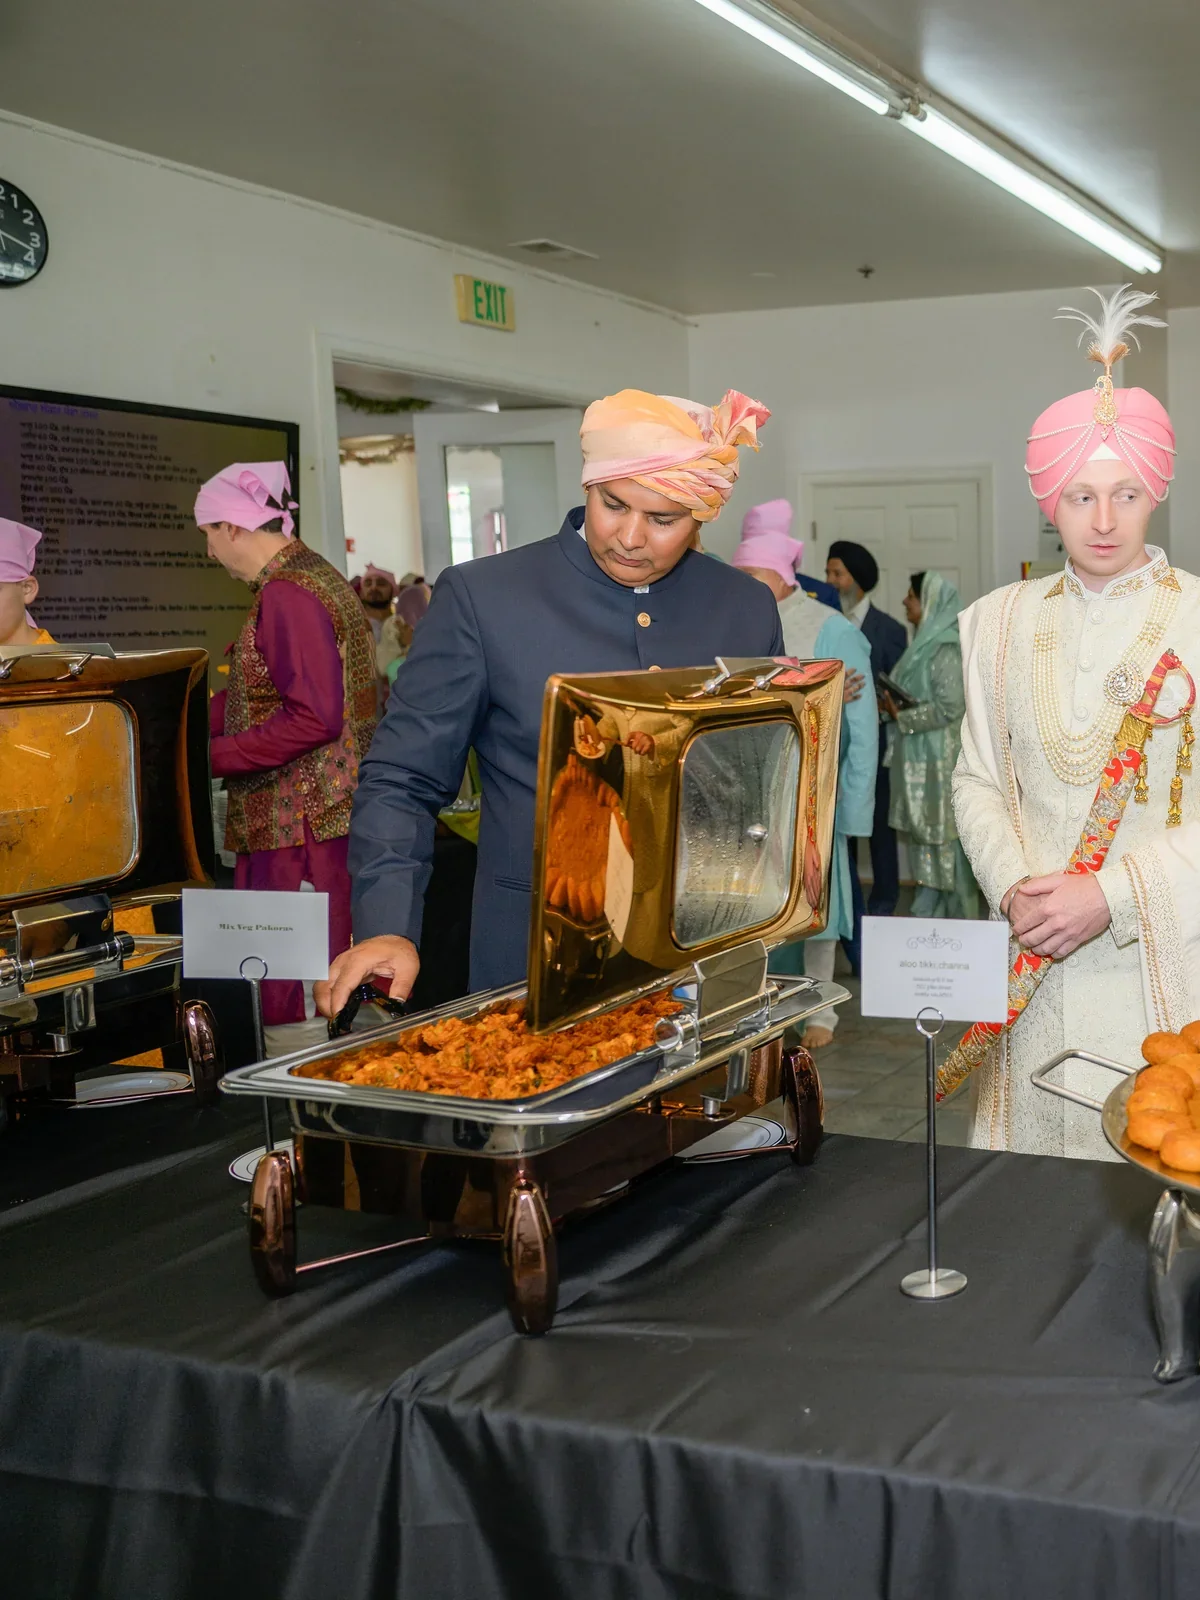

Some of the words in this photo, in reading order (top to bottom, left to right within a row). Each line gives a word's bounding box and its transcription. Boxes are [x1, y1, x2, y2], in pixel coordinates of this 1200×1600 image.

[11, 193, 18, 209] 1
[23, 209, 35, 226] 2
[30, 232, 40, 248] 3
[23, 250, 36, 265] 4
[473, 280, 506, 323] EXIT
[237, 923, 253, 931] Veg
